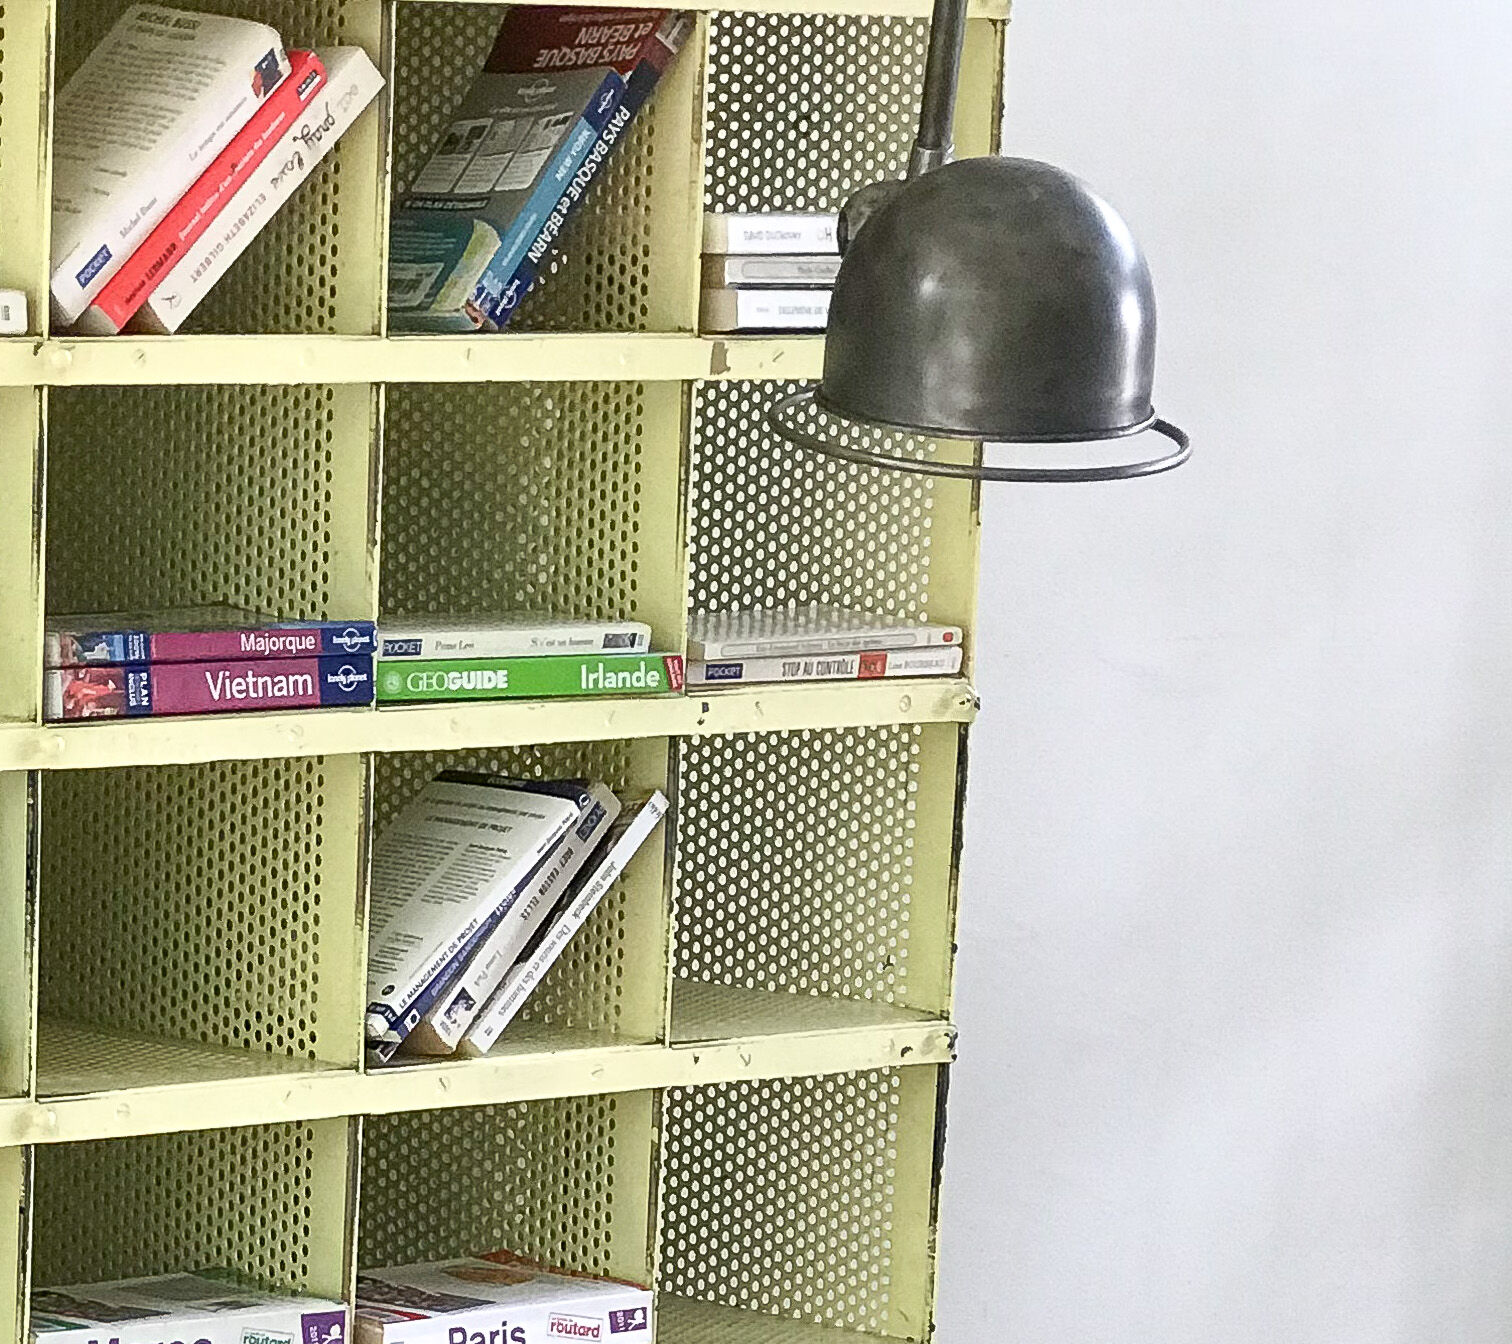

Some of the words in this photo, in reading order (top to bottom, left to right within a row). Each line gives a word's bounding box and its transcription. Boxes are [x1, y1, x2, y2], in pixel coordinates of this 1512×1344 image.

[599, 104, 631, 144] PAYS
[564, 139, 610, 200] BASQUE
[555, 195, 573, 214] et
[524, 211, 568, 265] BÉARN
[240, 632, 316, 655] Majorque
[383, 641, 422, 654] POCKET
[581, 662, 660, 690] Irlande
[782, 661, 800, 677] STOP
[803, 661, 813, 676] AU
[816, 658, 854, 675] CONTRÔLE
[140, 673, 149, 705] PLAN
[205, 670, 313, 701] Vietnam
[551, 1322, 600, 1338] routard
